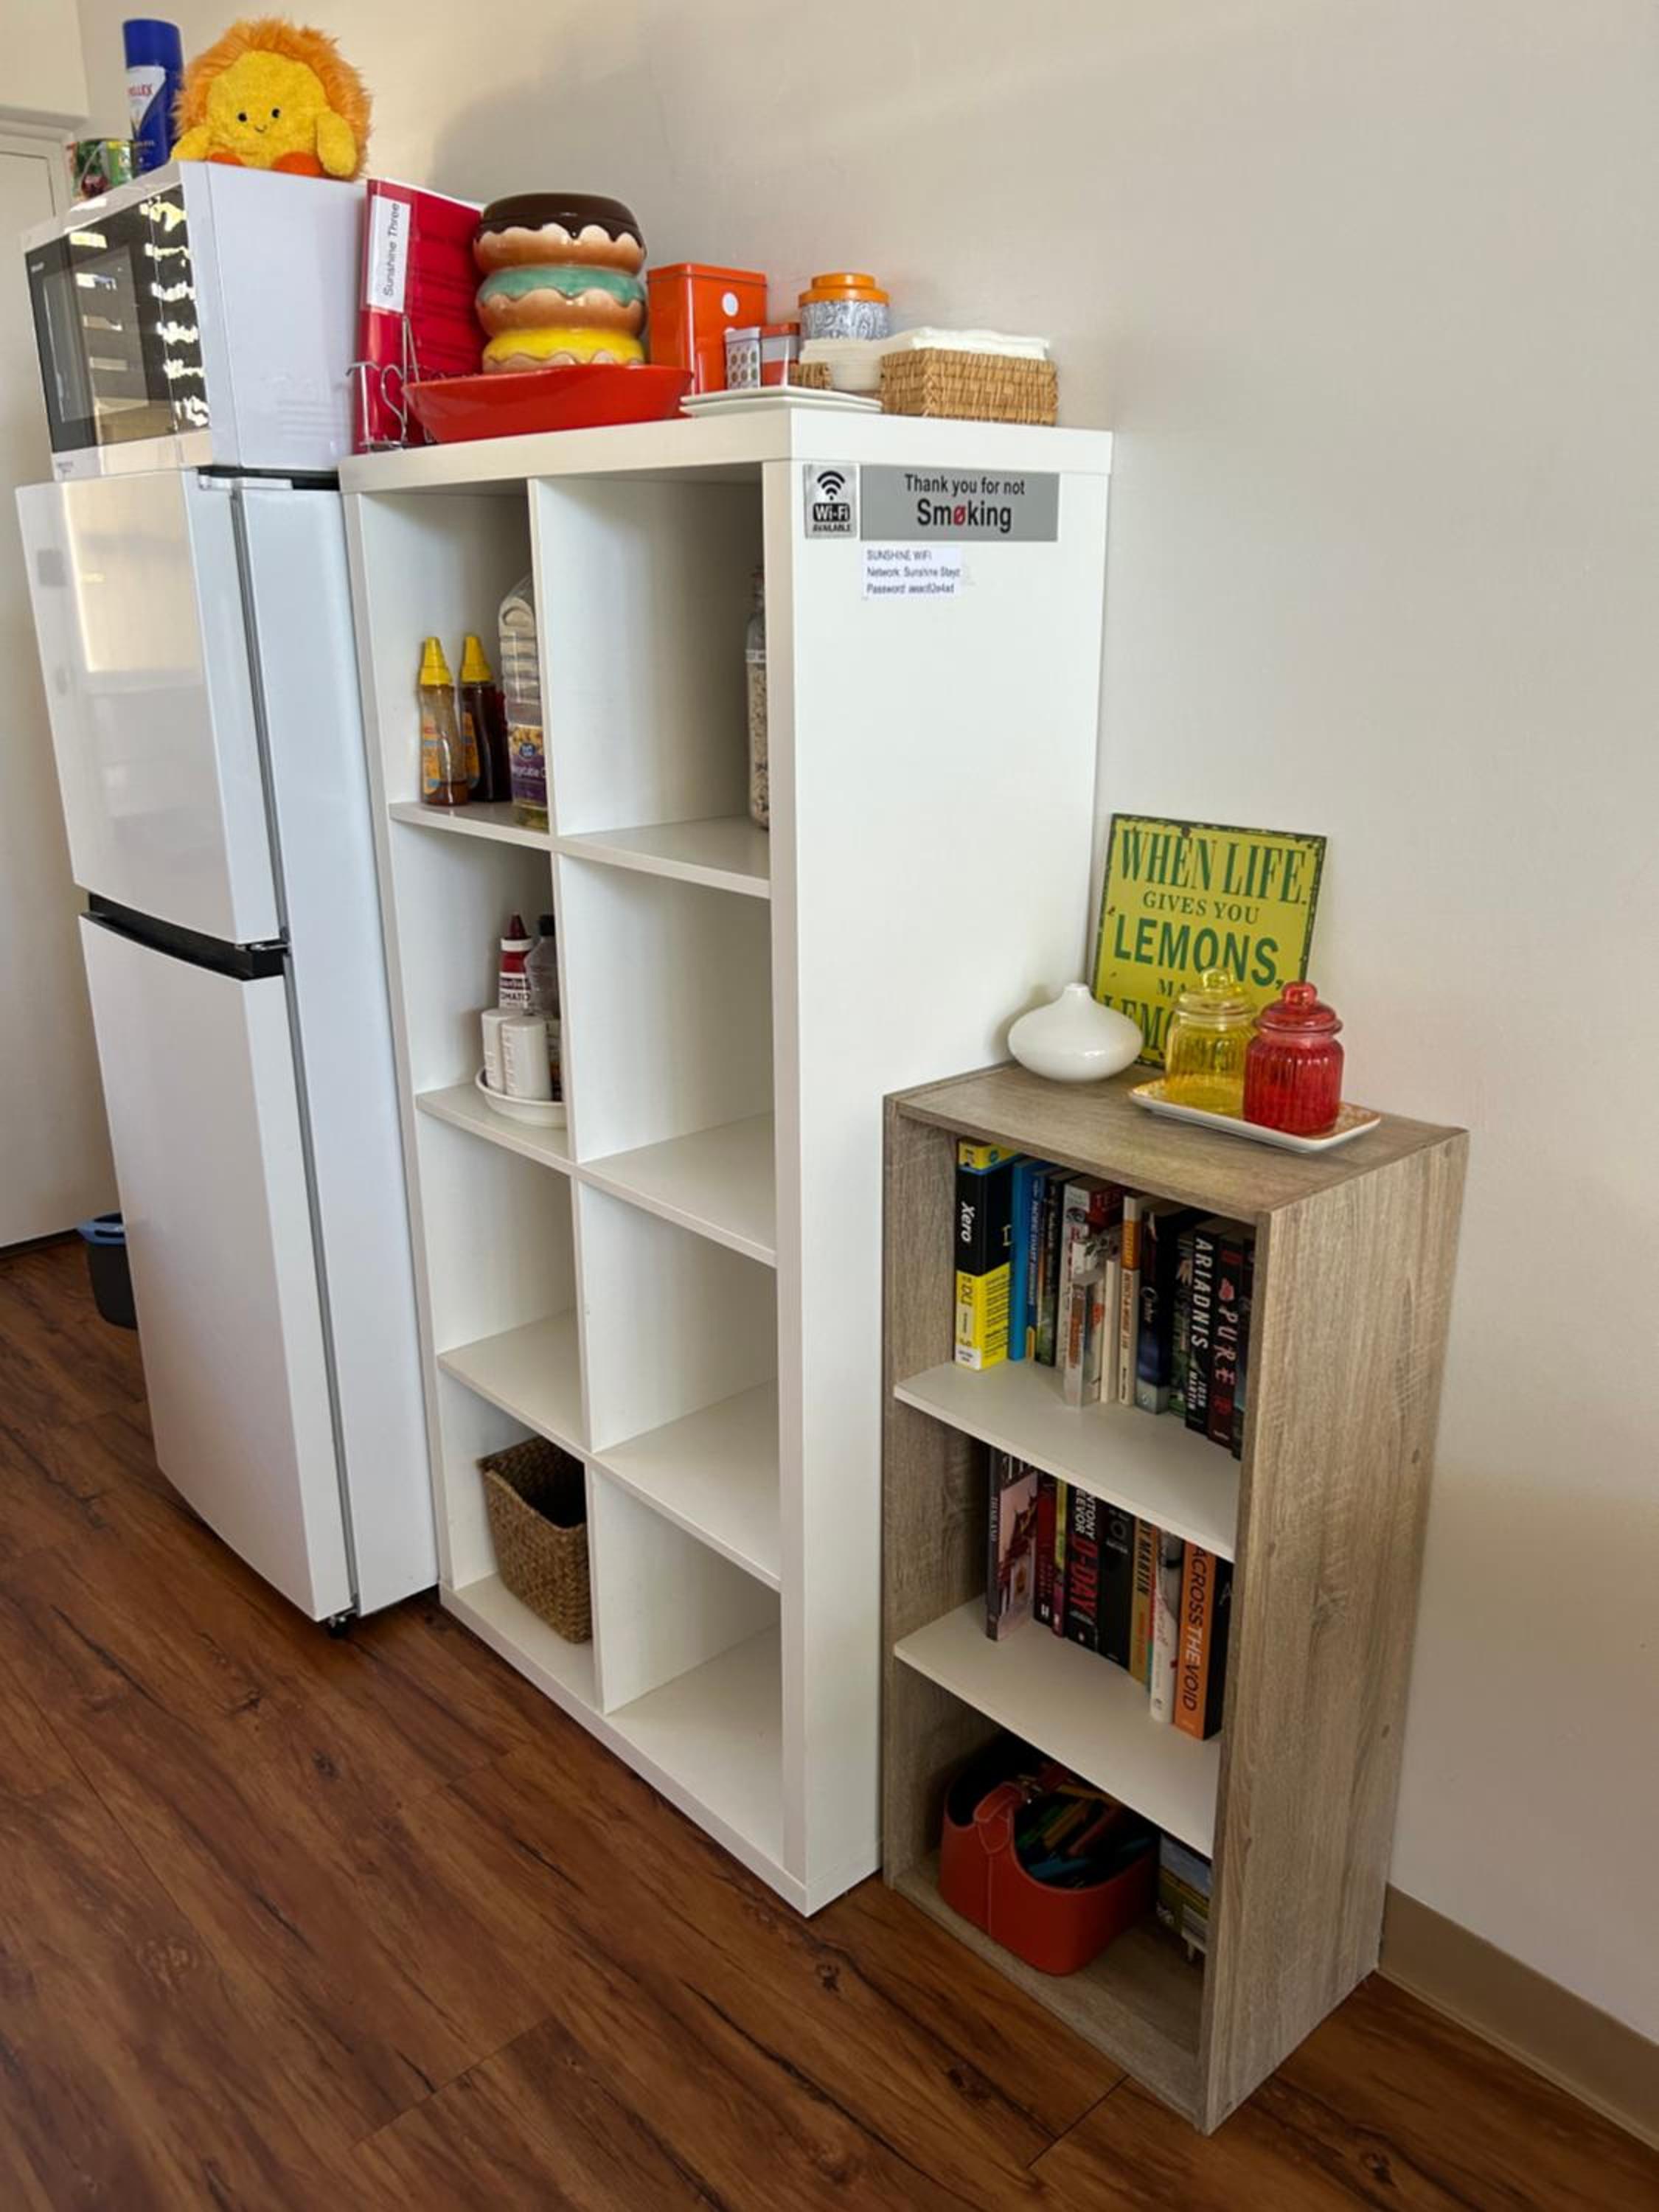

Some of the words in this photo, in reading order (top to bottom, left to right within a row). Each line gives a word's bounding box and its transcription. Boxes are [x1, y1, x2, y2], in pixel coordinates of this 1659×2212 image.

[387, 203, 400, 237] Three
[383, 241, 397, 296] Sunshine
[904, 473, 948, 493] Thank
[951, 480, 978, 498] you
[981, 477, 1001, 495] for
[1003, 479, 1026, 495] not
[813, 523, 851, 532] AVAILABLE
[814, 505, 849, 521] Wi-Fi
[1120, 827, 1218, 892] WHEN
[1143, 890, 1208, 916] GIVES
[1214, 902, 1260, 925] YOU
[1113, 914, 1284, 990] LEMONS,
[960, 1200, 975, 1243] Xero
[1190, 1237, 1214, 1349] ARIADNIS
[1214, 1307, 1239, 1386] PURE
[1187, 1368, 1199, 1411] MARTIN
[1069, 1534, 1099, 1620] D-DAY
